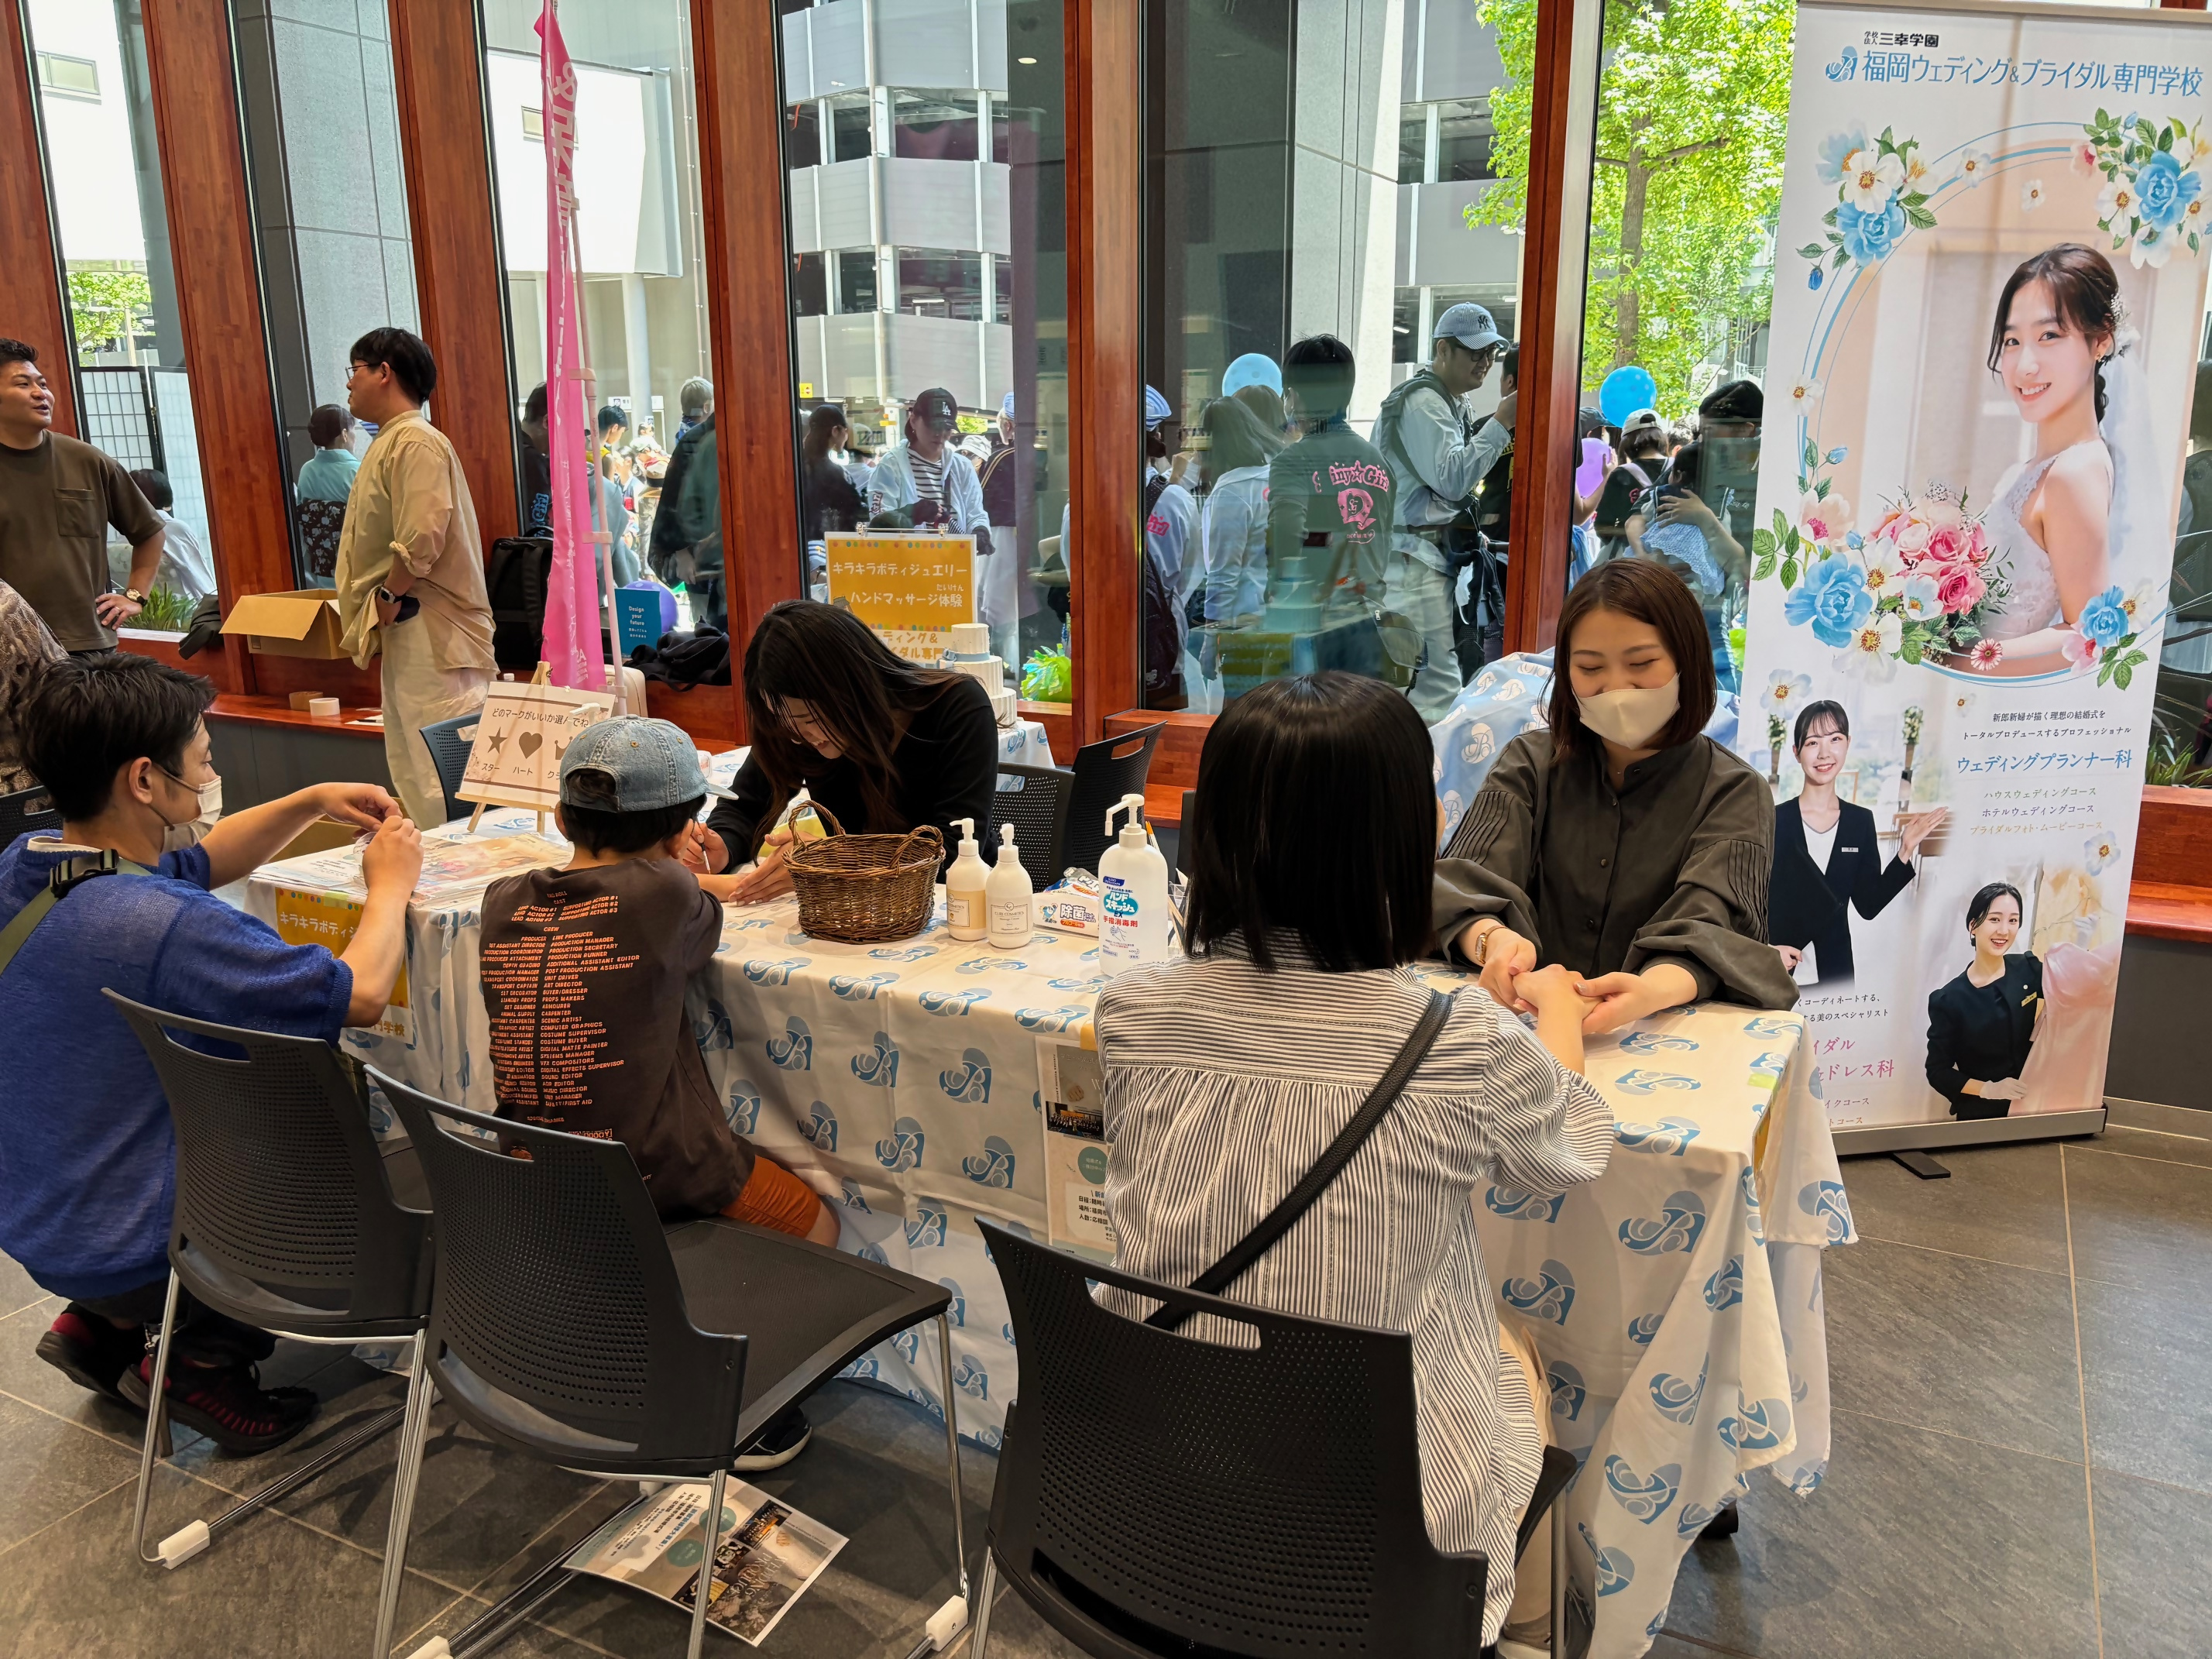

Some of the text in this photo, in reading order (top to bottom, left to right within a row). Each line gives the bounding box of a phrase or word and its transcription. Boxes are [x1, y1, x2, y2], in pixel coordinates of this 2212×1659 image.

[1879, 33, 1939, 47] 三幸学園
[833, 562, 967, 577] キラキラボディジュエリー
[936, 583, 964, 592] たいけん
[850, 592, 963, 608] ハンドマッサージ体験
[1992, 710, 2105, 722] 新郎新婦が描く理想の結婚式を
[482, 763, 500, 771] スター
[1957, 749, 2132, 774] ウェディングプランナー科
[513, 766, 533, 775] ハート
[1984, 787, 2097, 799] ハウスウェディングコース
[1982, 805, 2094, 817] ホテルウェディングコース
[1109, 891, 1129, 902] ハンド
[1060, 903, 1086, 920] 除菌
[1105, 899, 1135, 913] スキッシュ
[1103, 915, 1139, 928] 手指消毒剤
[568, 1028, 606, 1036] SUPERVISOR
[588, 1060, 624, 1070] SUPERVISOR
[744, 1553, 788, 1598] WEDDING
